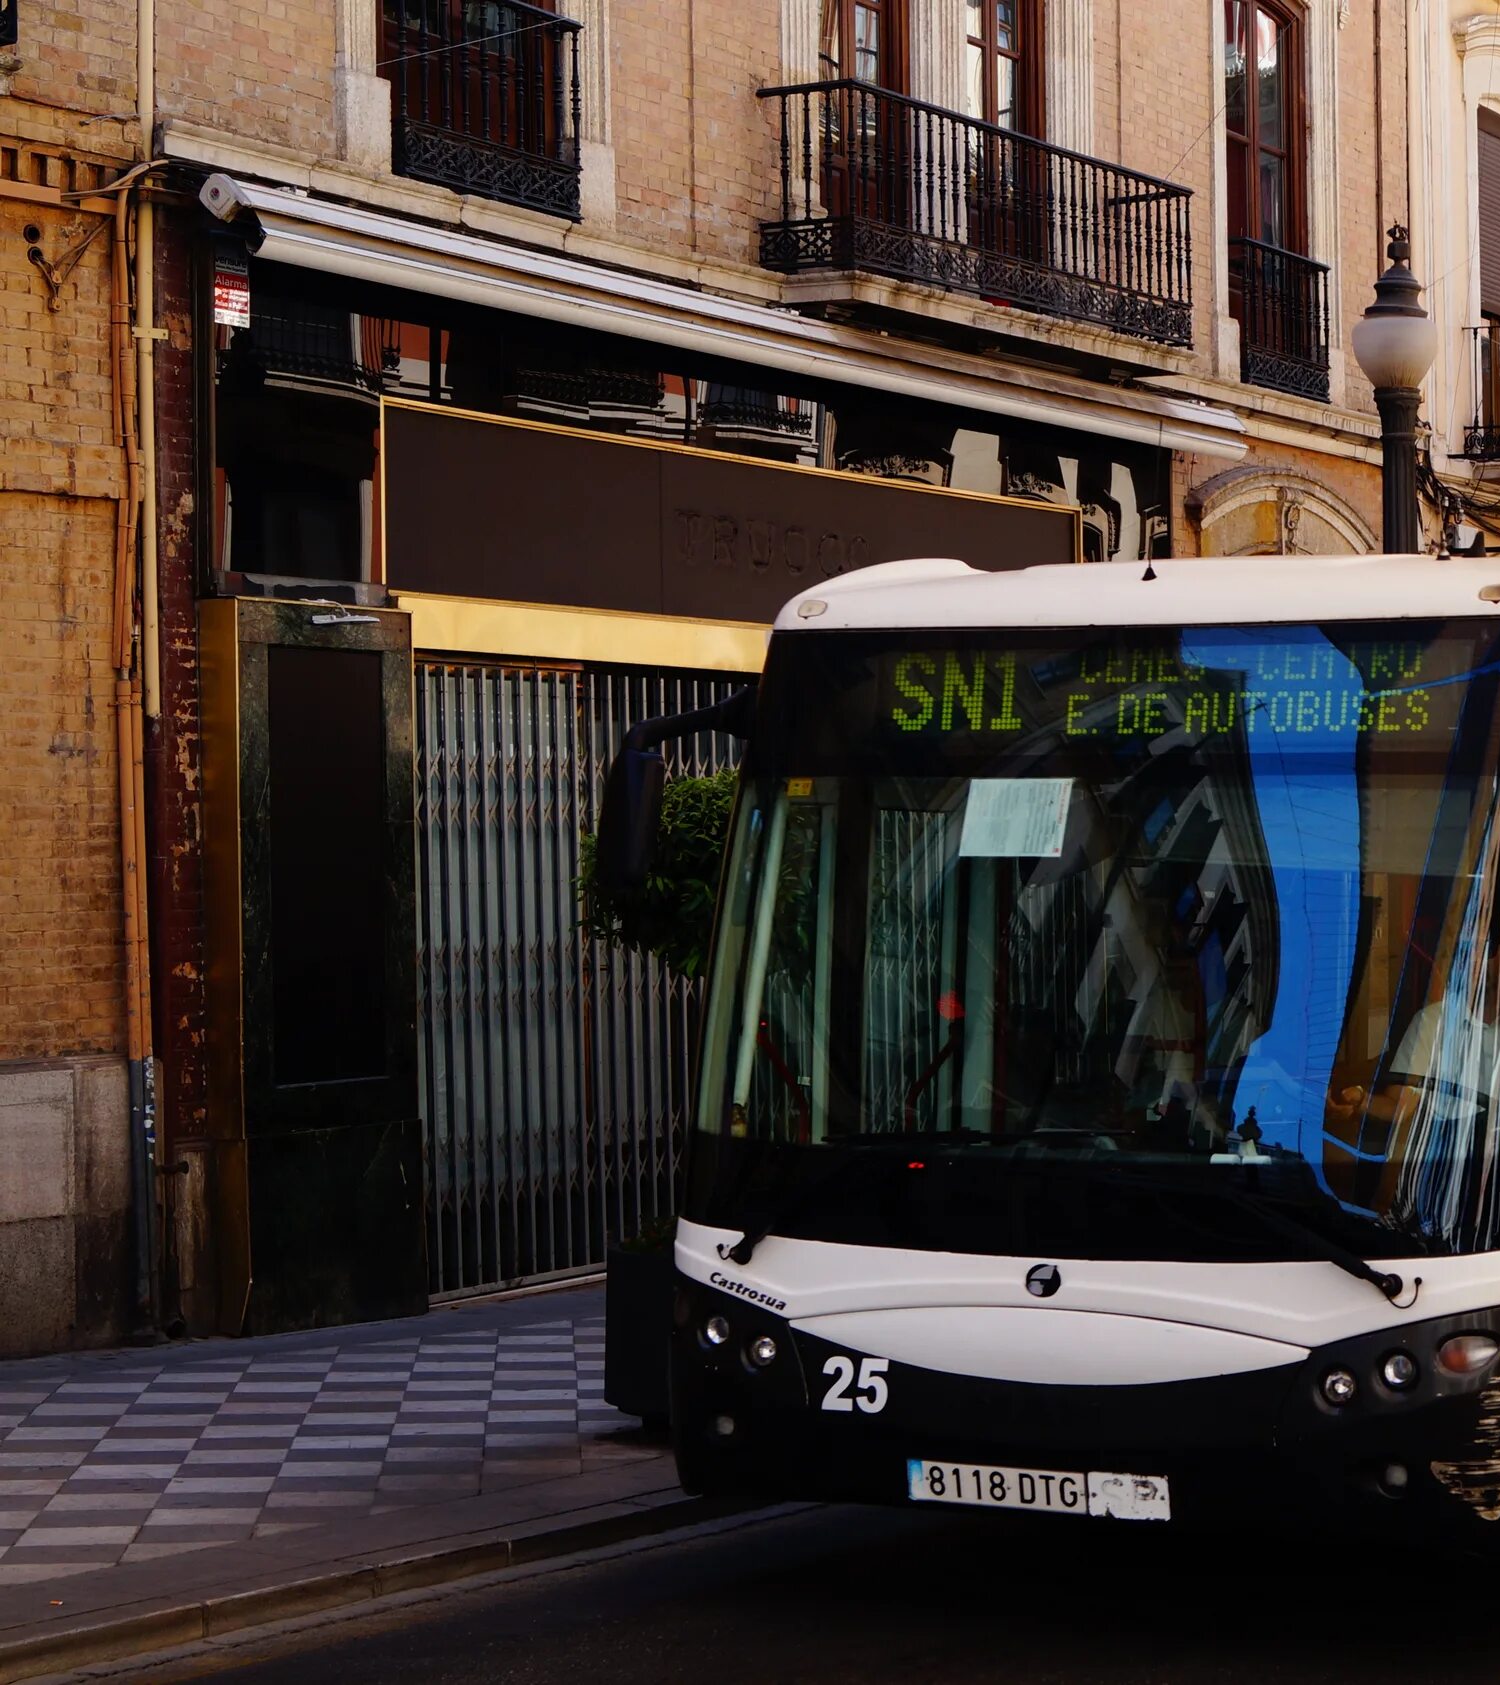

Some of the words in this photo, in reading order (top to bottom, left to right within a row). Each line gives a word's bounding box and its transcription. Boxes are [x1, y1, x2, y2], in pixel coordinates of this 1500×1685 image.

[215, 274, 248, 290] Alarma
[892, 649, 1023, 731] SN1
[1117, 692, 1168, 736] DE
[1184, 688, 1431, 735] AUTOBUSES
[710, 1271, 787, 1311] Castrosua
[821, 1355, 889, 1414] 25
[928, 1465, 1007, 1502] 8118
[1018, 1472, 1078, 1508] DTG
